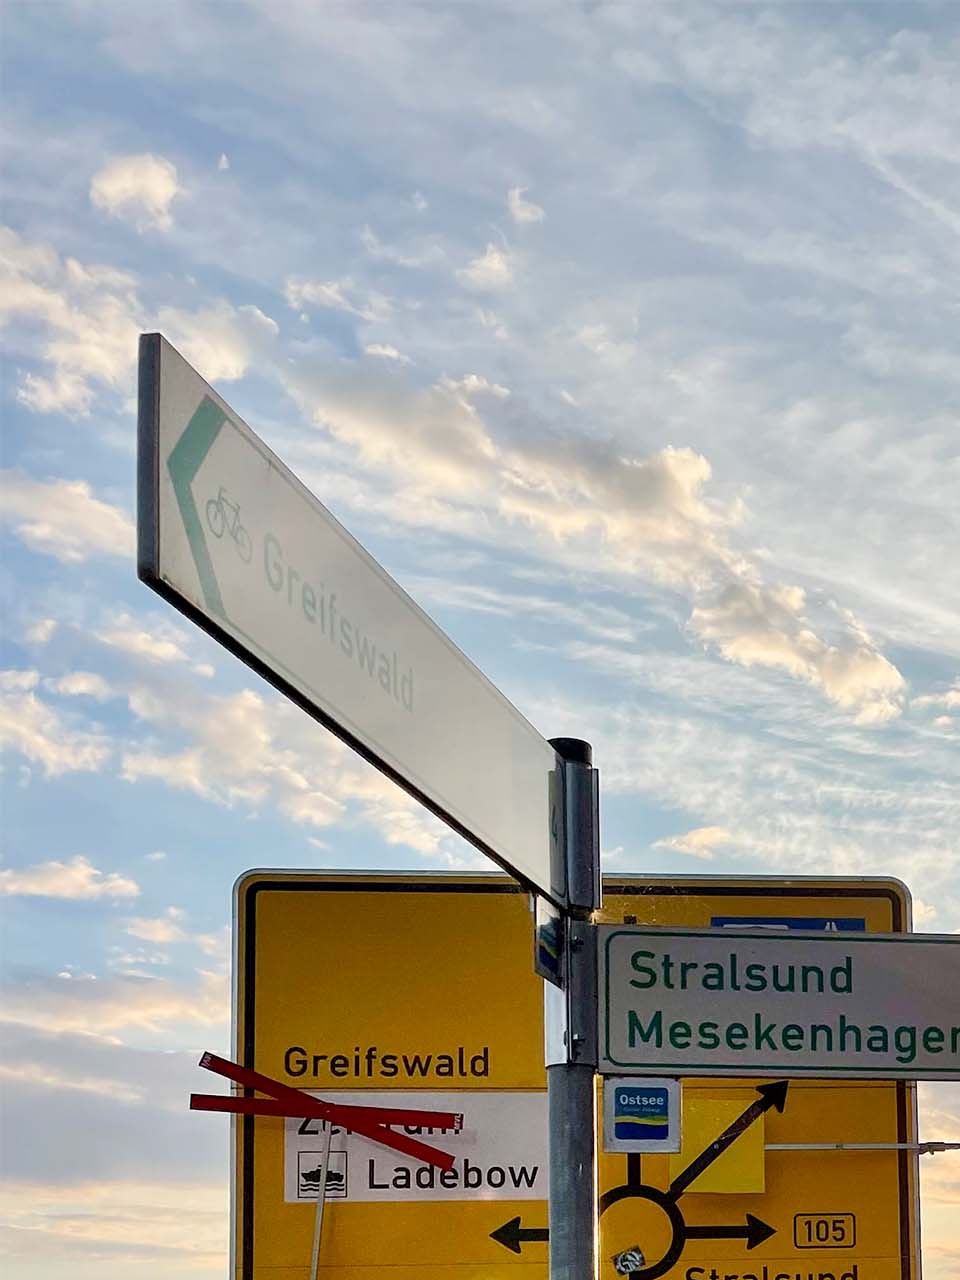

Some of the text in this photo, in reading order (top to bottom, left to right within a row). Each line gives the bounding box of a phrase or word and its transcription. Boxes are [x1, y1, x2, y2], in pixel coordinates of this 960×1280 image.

[264, 532, 413, 713] Greifswald
[629, 951, 853, 993] Stralsund
[284, 1046, 489, 1077] Greifswald
[619, 1094, 664, 1106] Ostsee
[368, 1158, 539, 1189] Ladebow
[804, 1219, 846, 1242] 105
